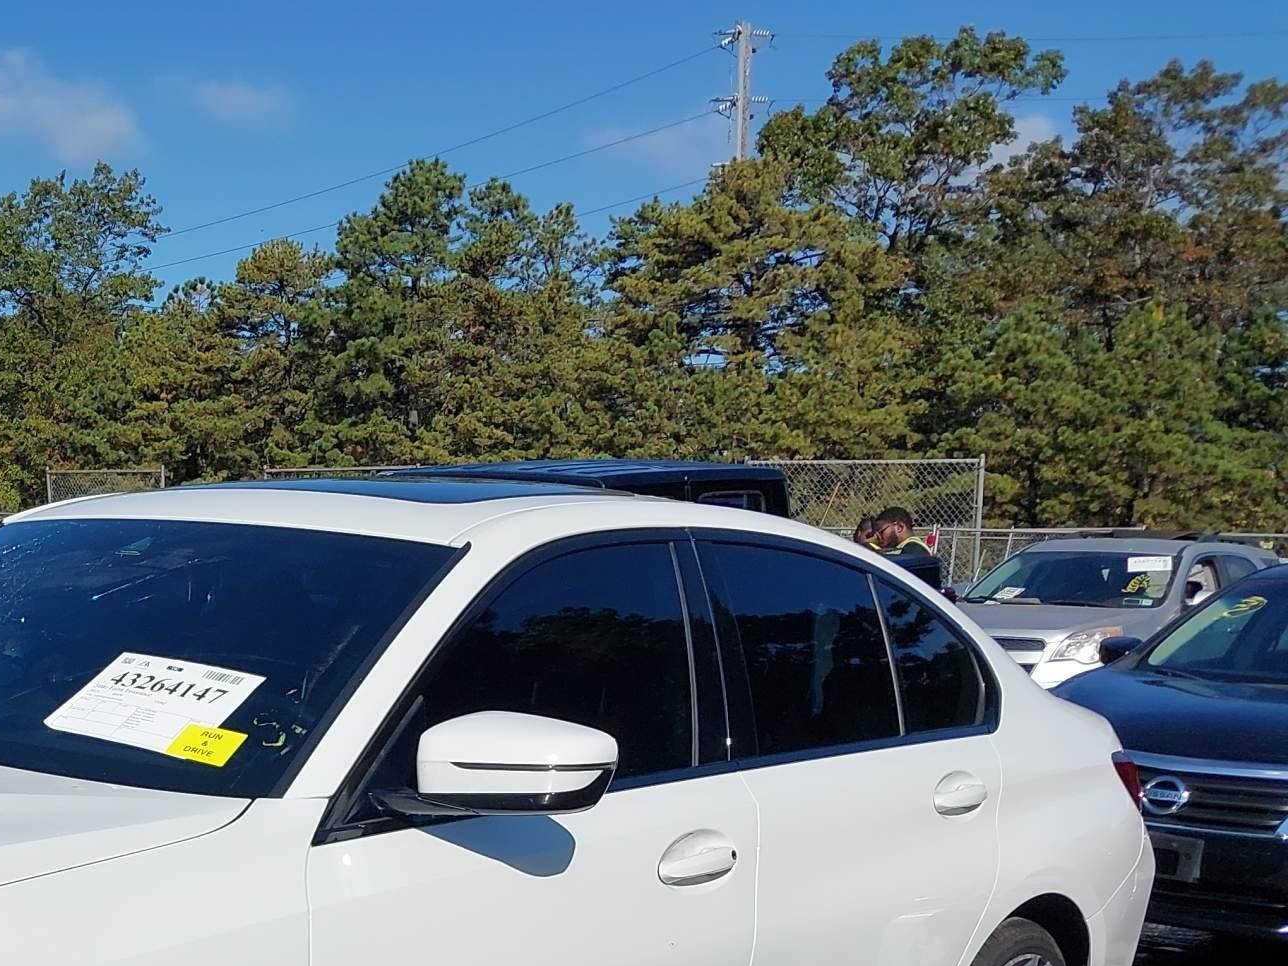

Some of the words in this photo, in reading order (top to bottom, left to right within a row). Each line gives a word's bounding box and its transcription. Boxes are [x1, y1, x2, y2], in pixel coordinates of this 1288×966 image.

[110, 671, 229, 704] 43264147
[200, 731, 224, 740] RUN
[183, 745, 215, 757] DRIVE
